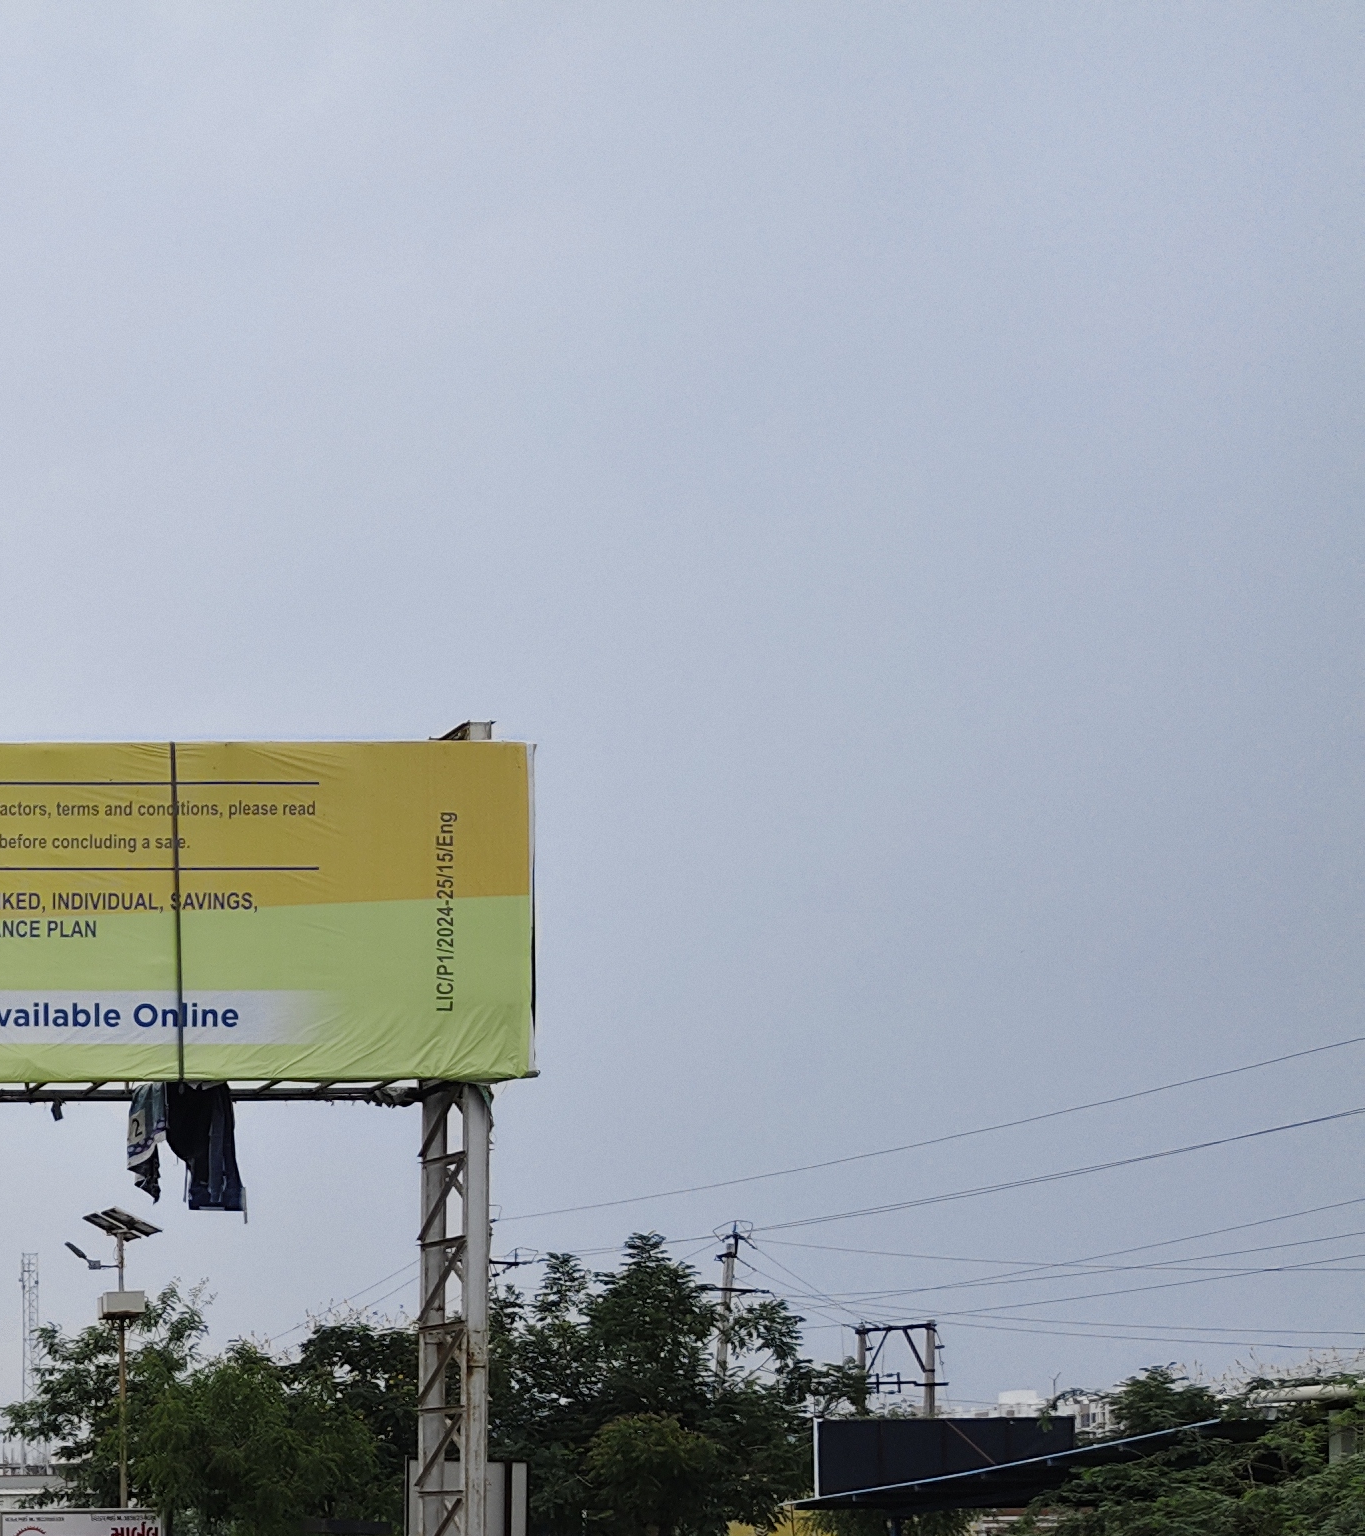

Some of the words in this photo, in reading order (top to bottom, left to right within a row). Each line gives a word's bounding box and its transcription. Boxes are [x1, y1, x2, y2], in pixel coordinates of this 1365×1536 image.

[56, 801, 100, 817] terms
[104, 801, 133, 817] and
[228, 800, 278, 819] please
[282, 800, 316, 817] read
[51, 834, 137, 853] concluding
[141, 838, 150, 849] a
[155, 834, 191, 849] sae.
[52, 892, 164, 913] INDIVIDUAL,
[170, 892, 258, 913] SAVINGS,
[436, 811, 458, 1012] LIC/P1/2024-25/15/Eng
[47, 919, 97, 938] PLAN
[133, 1002, 240, 1028] Online
[131, 1118, 143, 1138] 2
